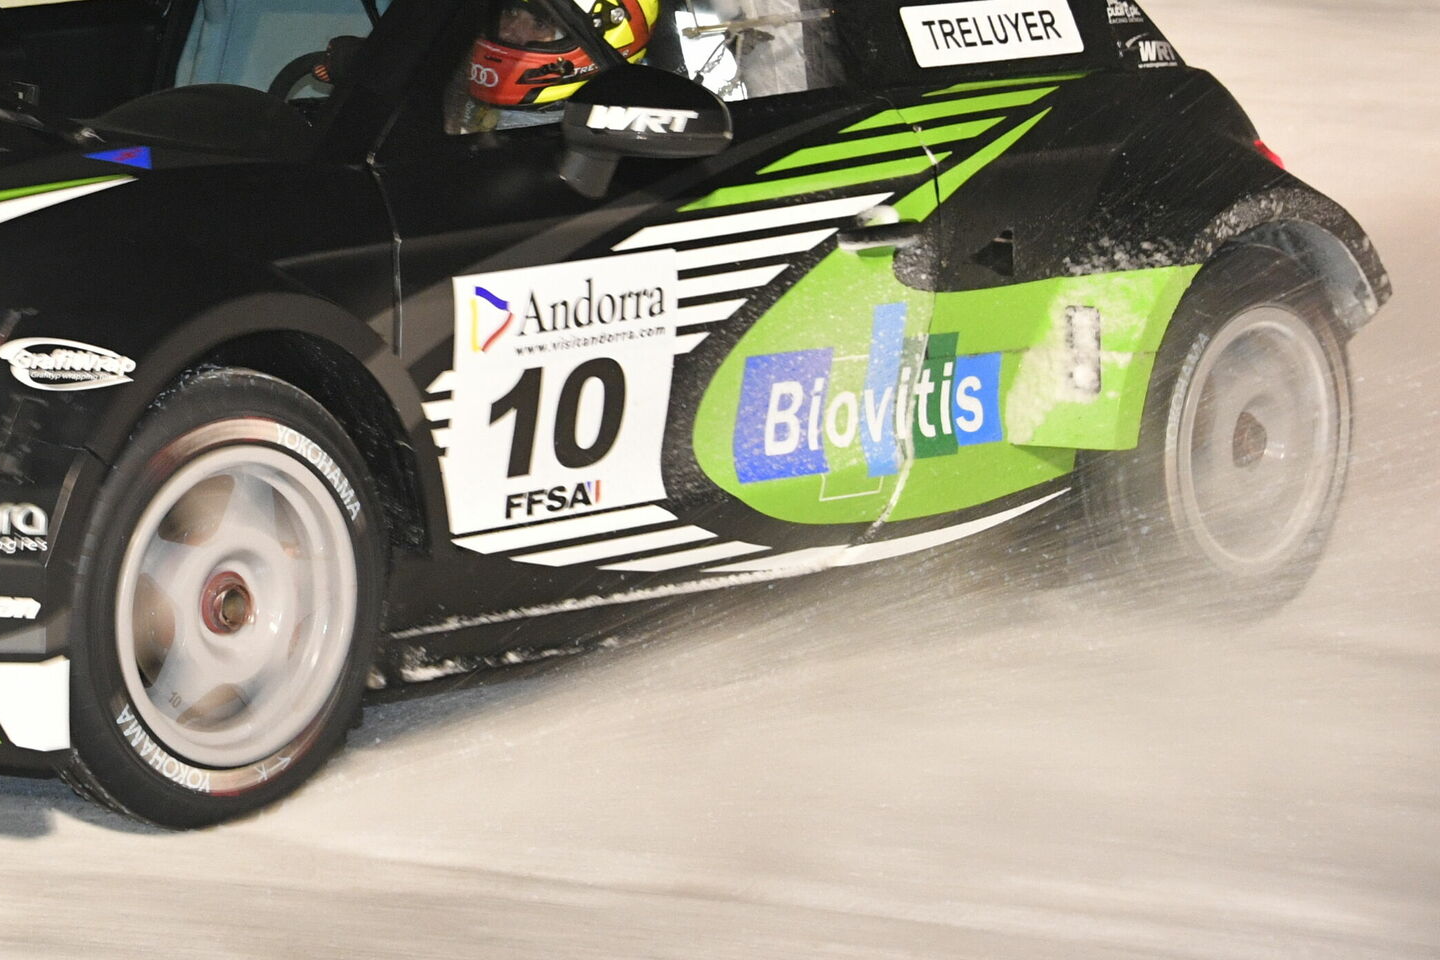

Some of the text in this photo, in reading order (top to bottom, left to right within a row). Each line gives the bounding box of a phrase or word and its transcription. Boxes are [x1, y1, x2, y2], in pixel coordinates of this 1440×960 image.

[921, 9, 1063, 50] TRELUYER
[586, 104, 699, 133] WRT
[517, 278, 667, 337] Andorra
[489, 357, 627, 479] 10
[763, 362, 984, 456] Biovitis
[276, 423, 361, 521] YOKOHAMA
[505, 482, 593, 520] FFSA
[116, 704, 211, 793] YOKOHAMA
